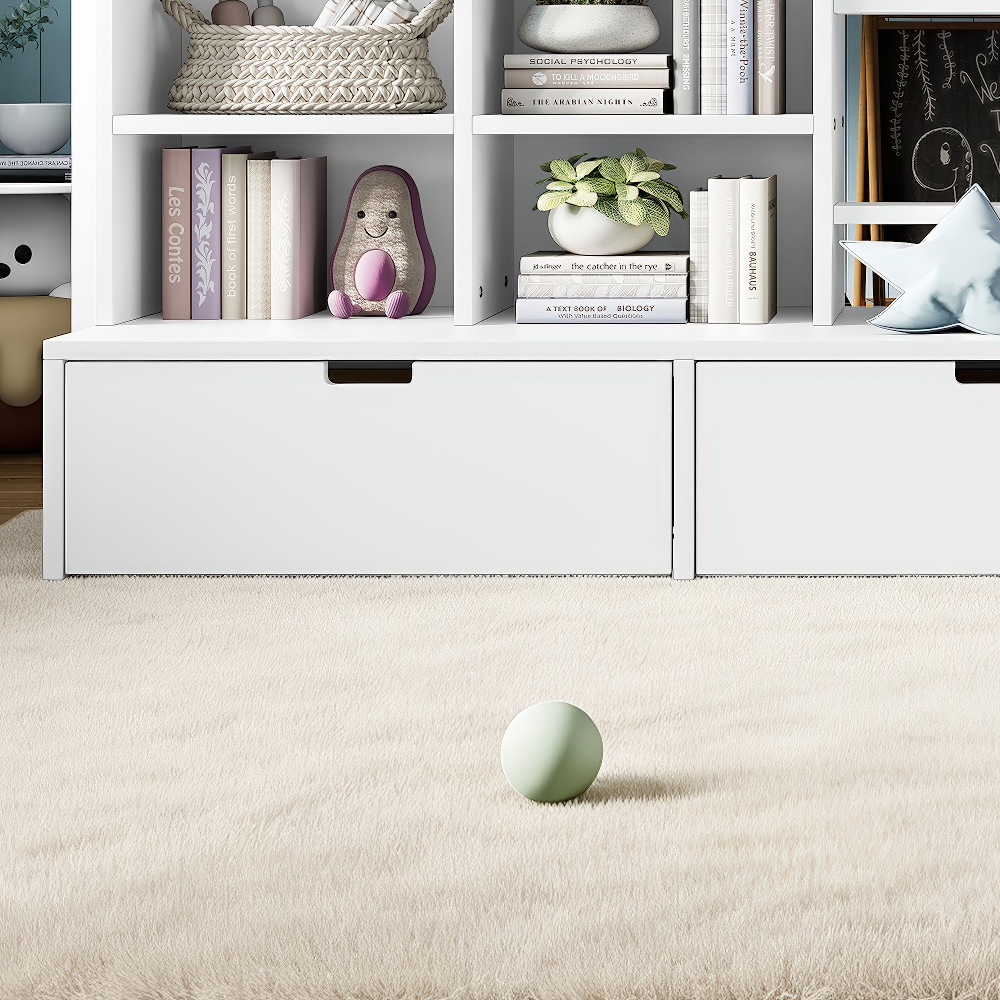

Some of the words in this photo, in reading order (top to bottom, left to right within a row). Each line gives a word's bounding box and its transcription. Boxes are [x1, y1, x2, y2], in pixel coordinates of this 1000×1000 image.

[765, 29, 775, 61] TWIST
[552, 73, 561, 81] TO
[563, 73, 578, 81] KILL
[579, 73, 585, 81] A
[168, 187, 185, 217] Les
[227, 175, 237, 215] words
[227, 219, 237, 244] first
[168, 222, 185, 284] Contes
[227, 247, 237, 261] of
[571, 262, 585, 270] the
[587, 262, 617, 270] catcher
[629, 262, 643, 270] the
[227, 265, 237, 298] book
[748, 251, 757, 291] BAUHAUS
